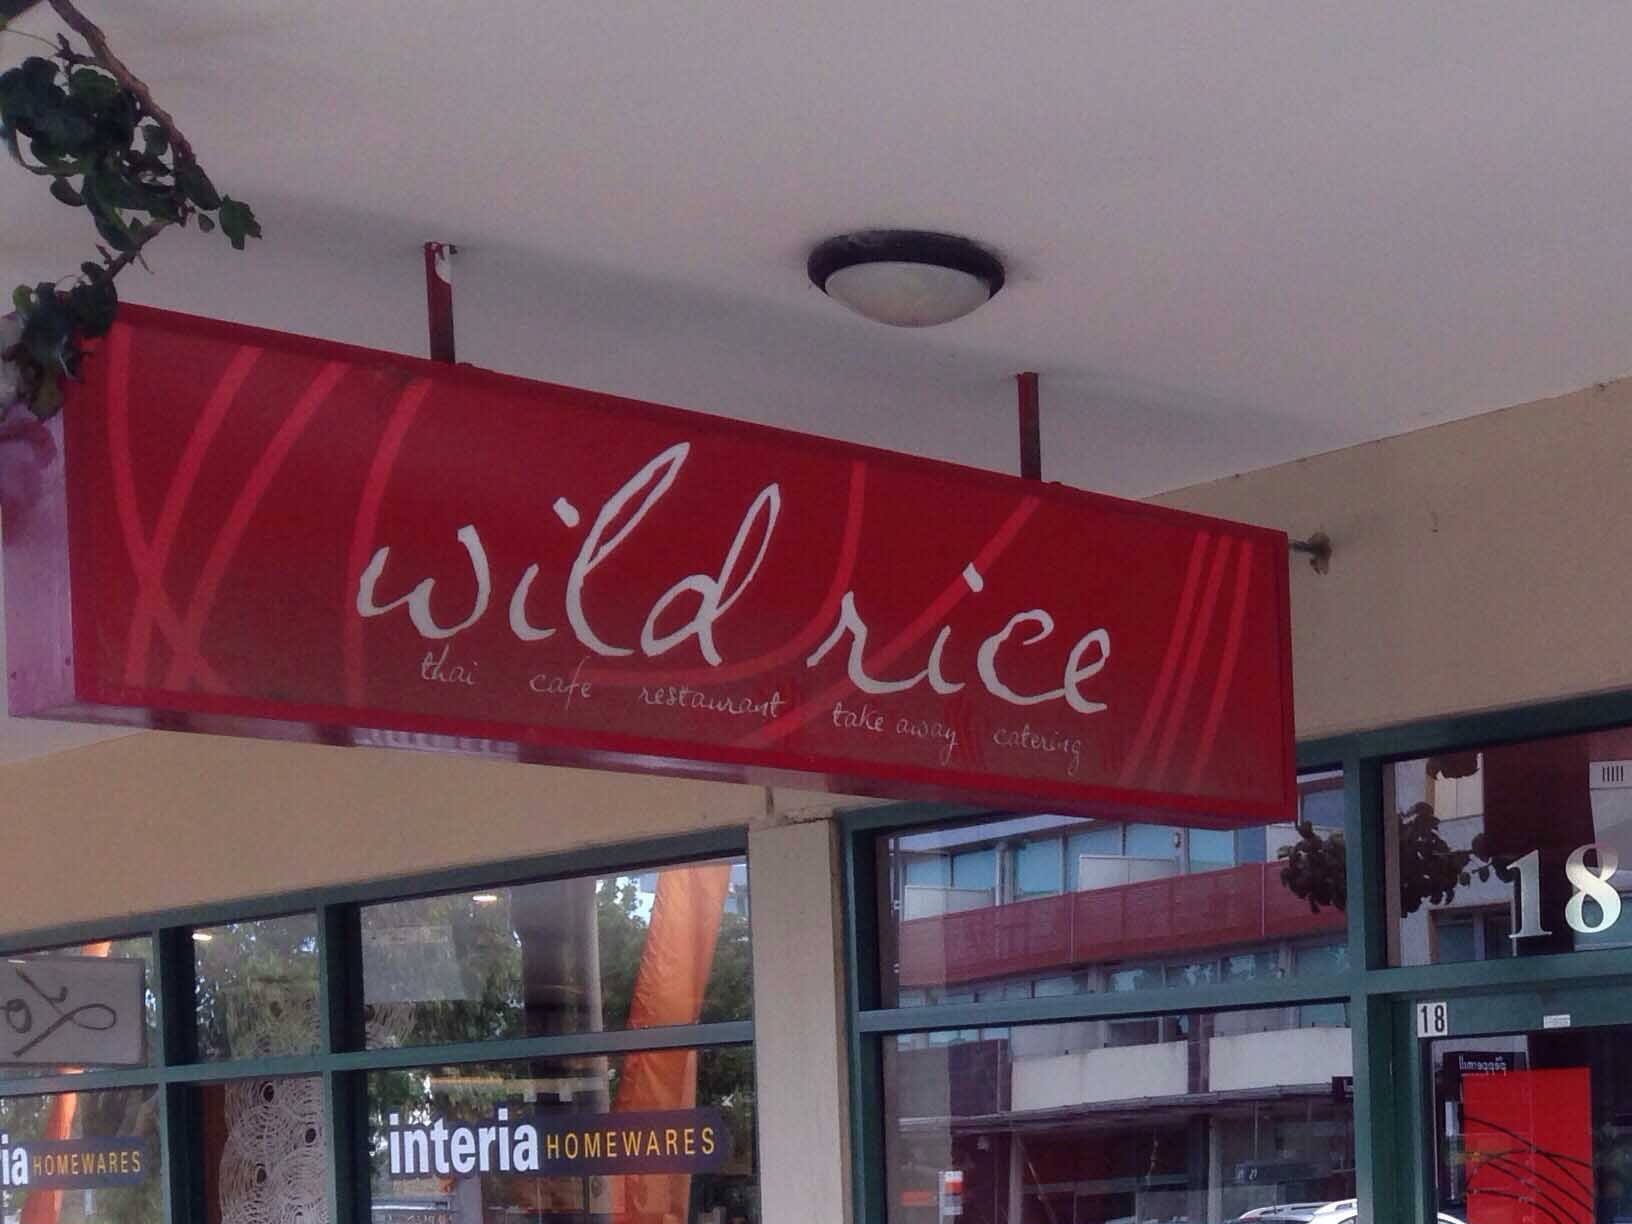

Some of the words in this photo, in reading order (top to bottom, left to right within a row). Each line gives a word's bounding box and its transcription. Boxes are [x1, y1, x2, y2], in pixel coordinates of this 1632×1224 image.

[356, 441, 782, 669] wild
[806, 562, 1111, 715] rice
[421, 643, 478, 686] thai
[529, 656, 593, 711] cafe
[638, 685, 785, 718] restaurant
[832, 701, 885, 734] take
[896, 715, 961, 767] away
[993, 723, 1083, 776] catering
[1505, 842, 1623, 940] 18
[1420, 1004, 1446, 1035] 18
[0, 1134, 29, 1186] ia
[32, 1151, 142, 1177] HOMEWARES
[389, 1106, 541, 1176] interia
[546, 1127, 716, 1161] HOMEWARES
